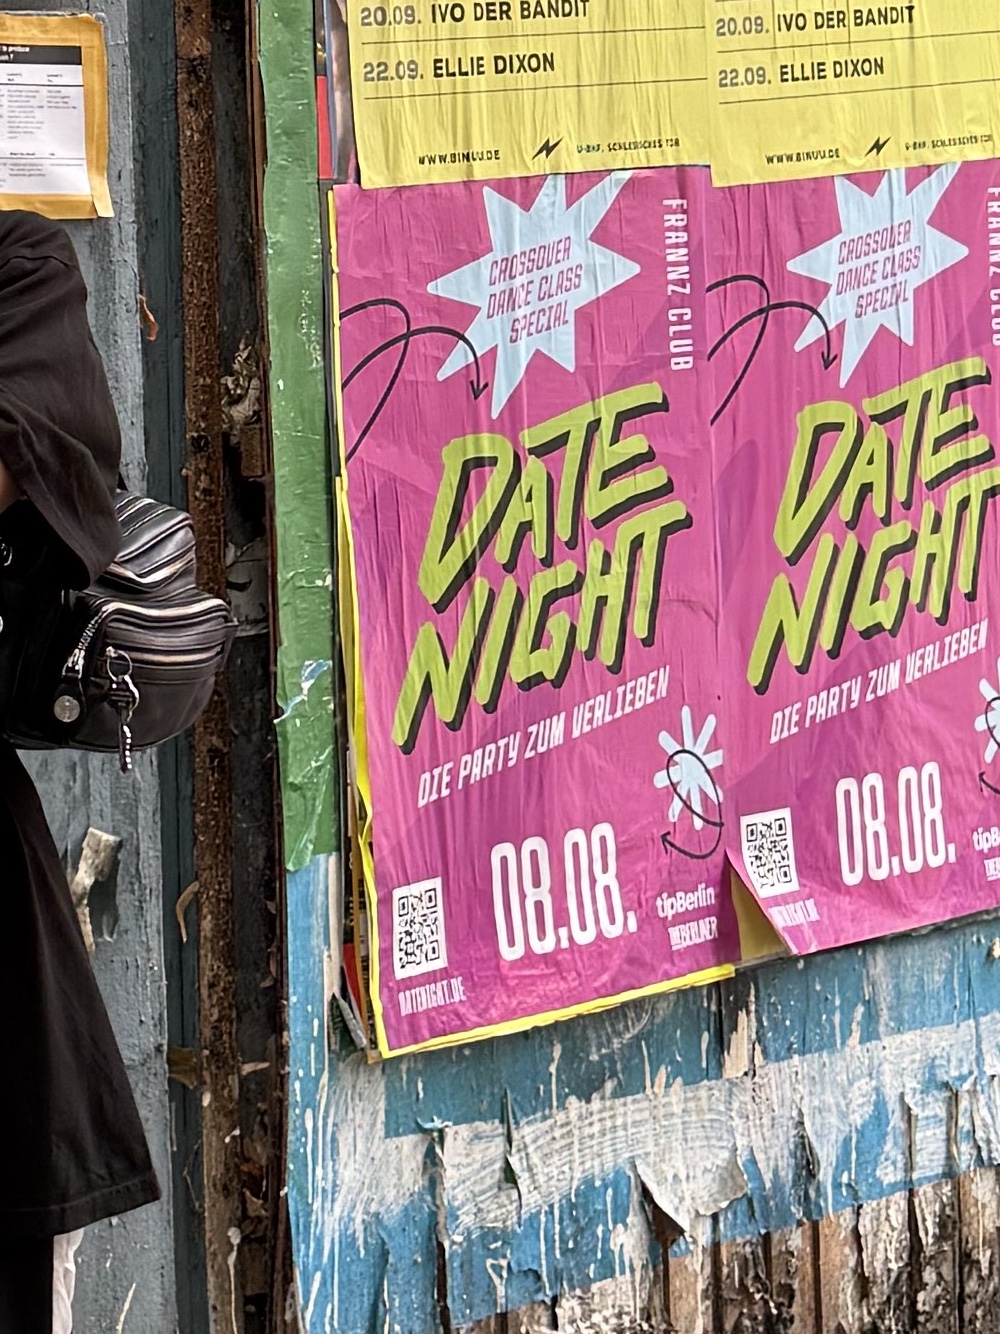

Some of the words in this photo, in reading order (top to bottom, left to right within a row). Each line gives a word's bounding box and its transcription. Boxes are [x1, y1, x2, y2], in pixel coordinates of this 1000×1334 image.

[360, 6, 422, 27] 20.09.
[431, 3, 465, 24] IVO
[473, 0, 512, 22] DER
[520, 0, 589, 20] BANDIT
[716, 16, 770, 37] 20.09.
[777, 13, 807, 33] IVO
[814, 10, 847, 30] DER
[853, 5, 915, 27] BANDIT
[363, 59, 424, 82] 22.09.
[433, 56, 486, 78] ELLIE
[493, 52, 555, 75] DIXON
[718, 66, 771, 88] 22.09.
[779, 61, 828, 83] ELLIE
[833, 57, 884, 79] DIXON
[489, 235, 572, 286] CROSSOVER
[663, 198, 691, 296] FRANNZ
[838, 219, 912, 265] CROSSOVER
[487, 284, 534, 319] DANCE
[538, 263, 583, 302] CLASS
[836, 262, 878, 296] DANCE
[881, 246, 921, 279] CLASS
[509, 300, 569, 343] SPECIAL
[854, 280, 909, 318] SPECIAL
[667, 307, 694, 371] CLUB
[773, 356, 991, 566] DATE
[418, 381, 670, 614] DATE
[747, 467, 1000, 695] NIGHT
[392, 500, 693, 755] NIGHT
[770, 702, 802, 744] DIE
[805, 675, 862, 728] PARTY
[865, 660, 900, 702] ZUM
[905, 618, 989, 683] VERLIEBEN
[417, 760, 454, 808] DIE
[457, 732, 521, 790] PARTY
[524, 711, 565, 759] ZUM
[571, 664, 670, 739] VERLIEBEN
[835, 762, 956, 886] 08.08.
[972, 826, 1000, 853] tipB
[490, 822, 638, 962] 08.08.
[656, 882, 715, 920] tipBerlin
